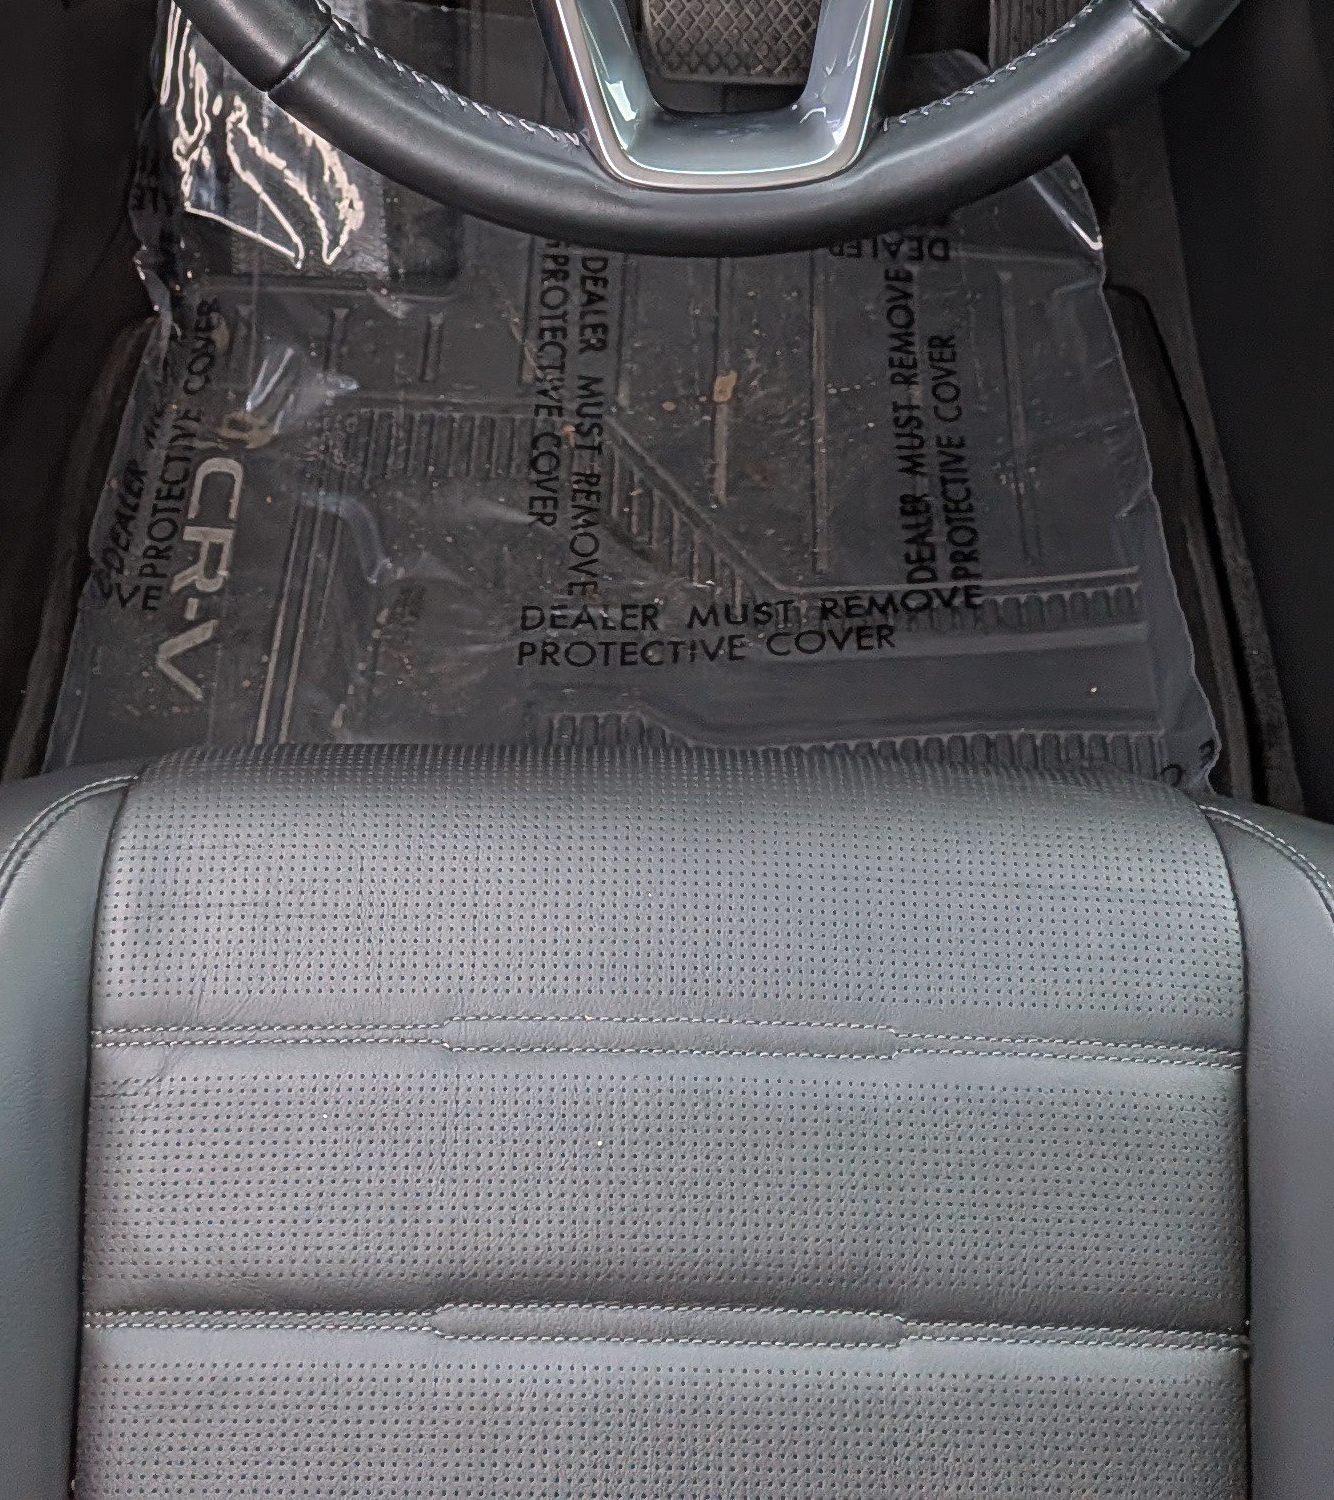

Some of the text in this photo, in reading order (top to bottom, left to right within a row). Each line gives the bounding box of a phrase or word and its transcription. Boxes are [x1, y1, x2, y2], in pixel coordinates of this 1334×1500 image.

[533, 249, 571, 419] PROTECTIVE
[885, 267, 918, 386] REMOVE
[139, 406, 203, 581] PROTECTIVE
[528, 430, 563, 528] COVER
[567, 255, 608, 598] DEALER MUST REMOVE
[893, 400, 926, 478] MUST
[928, 333, 982, 581] PROTECTIVE COVER
[147, 456, 244, 700] CR-V
[516, 624, 896, 667] PROTECTIVE COVER
[520, 584, 985, 632] DEALER MUST REMOVE
